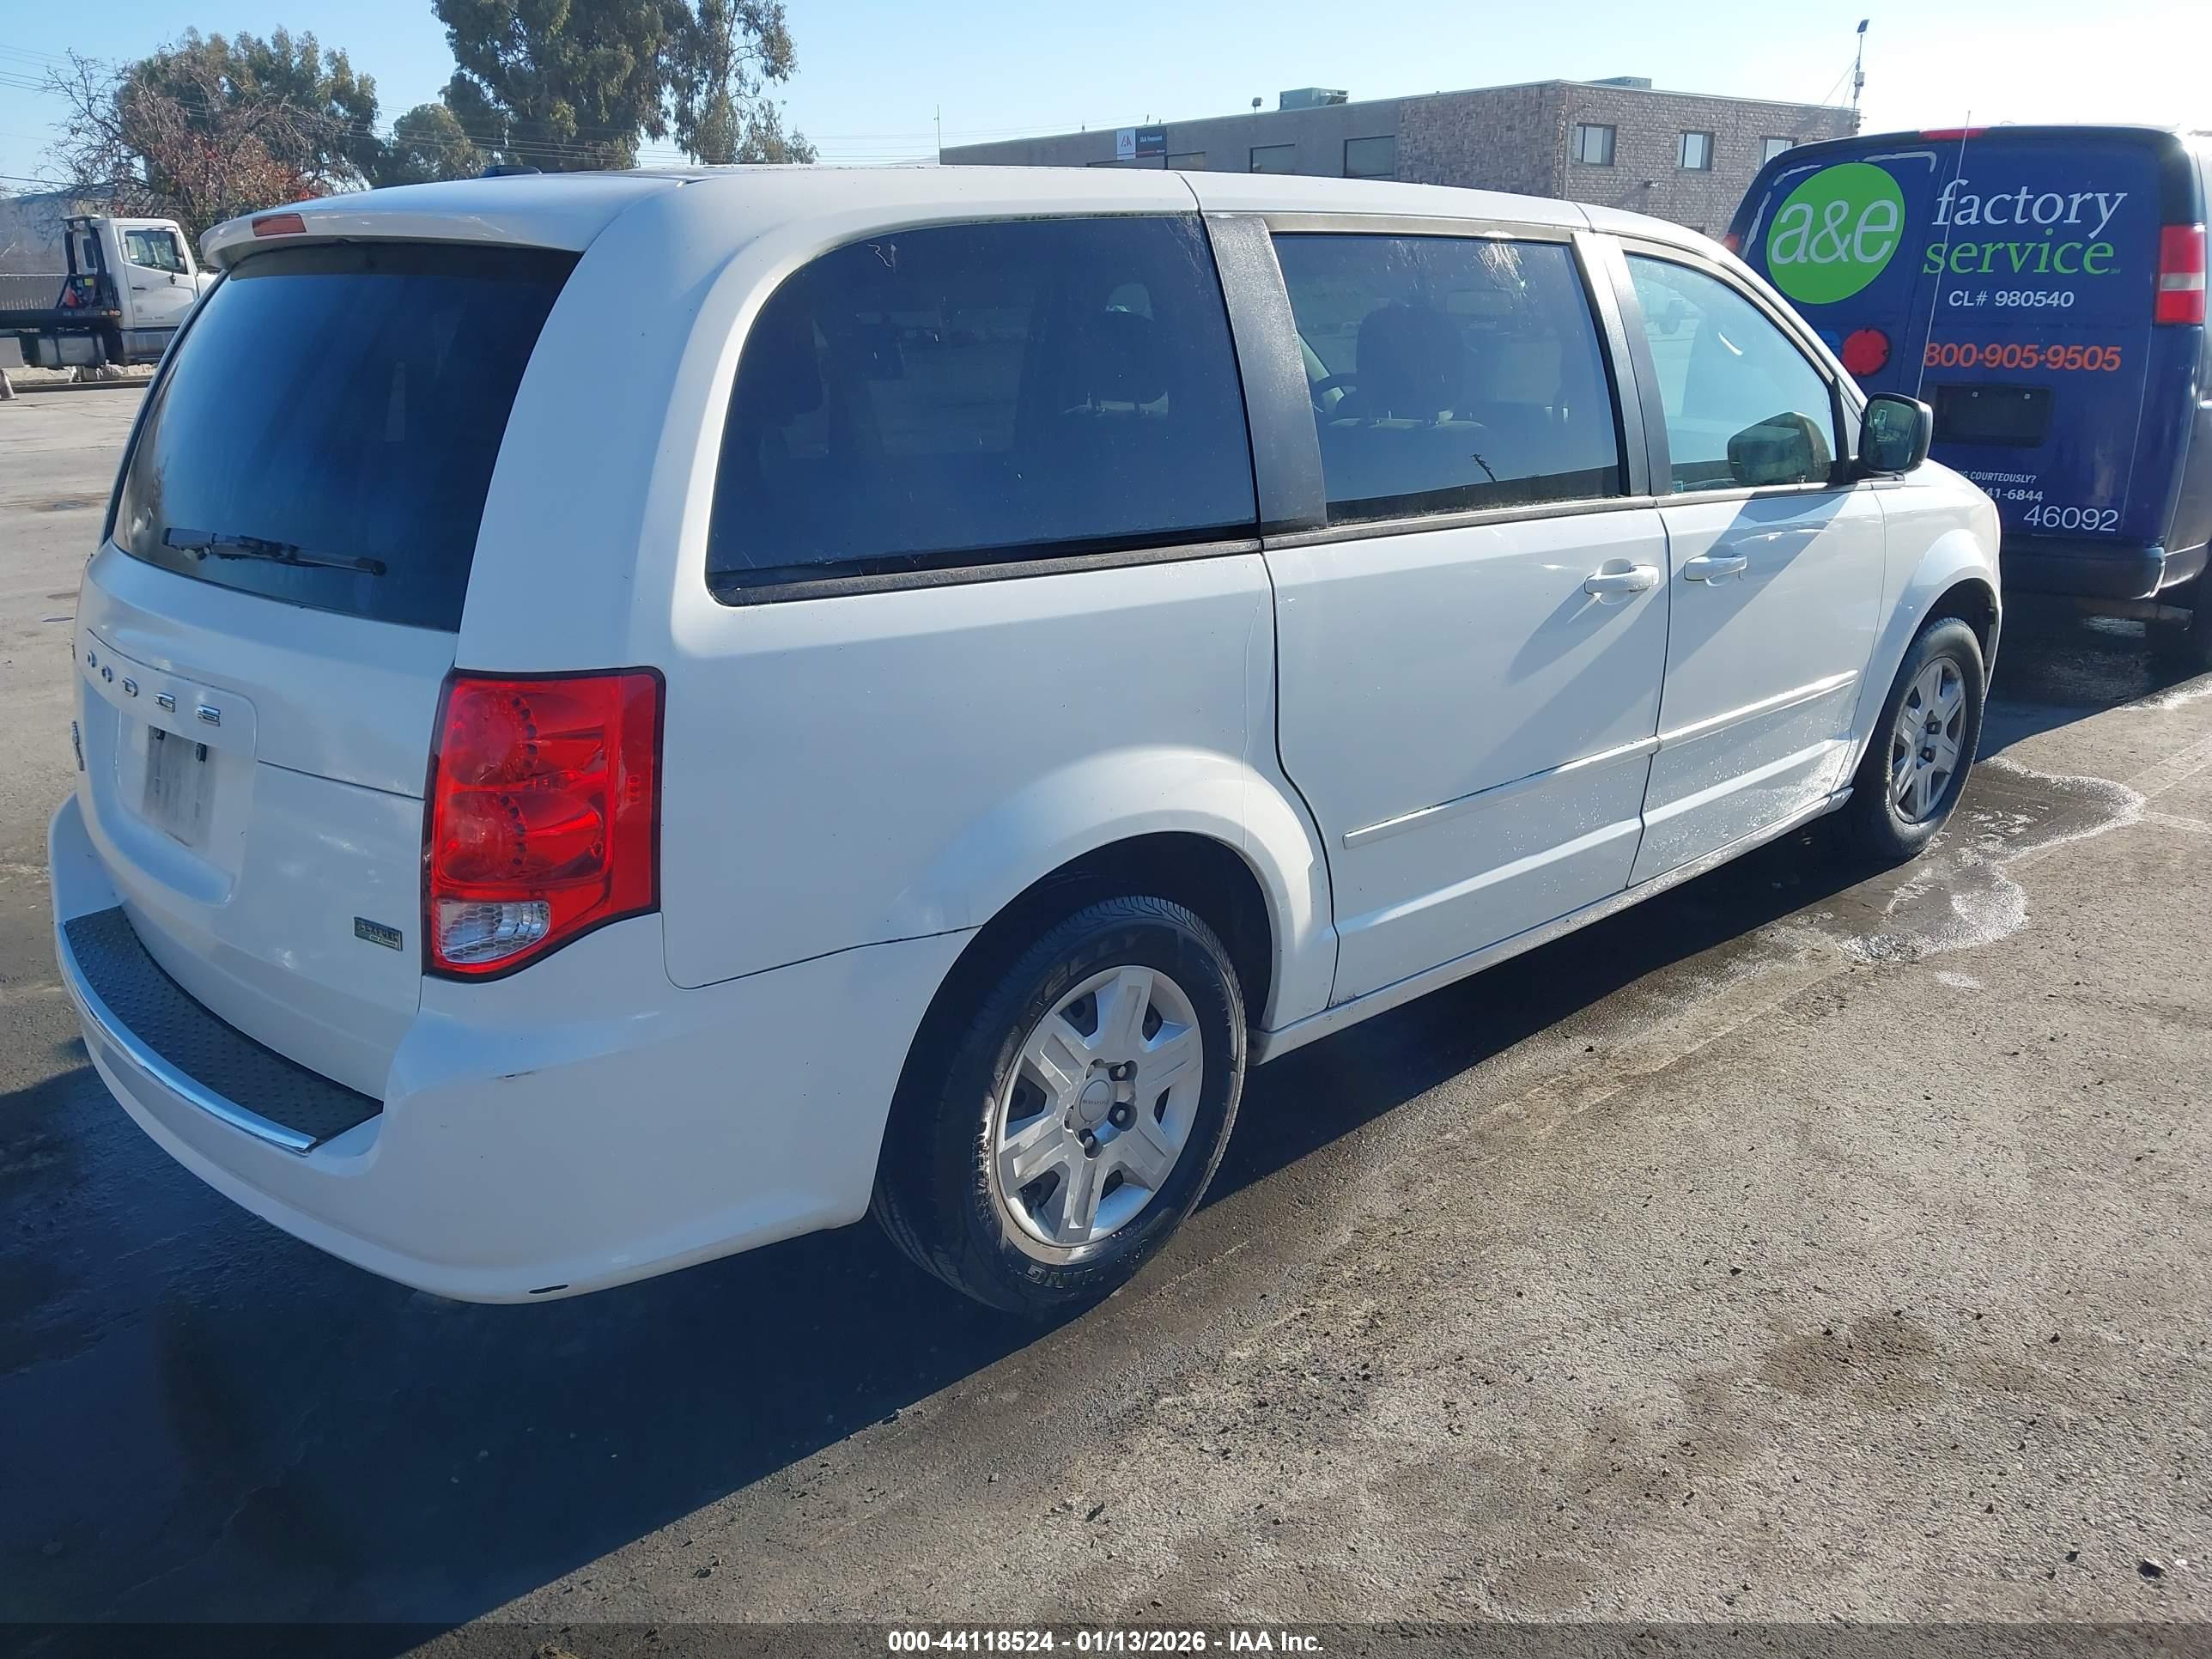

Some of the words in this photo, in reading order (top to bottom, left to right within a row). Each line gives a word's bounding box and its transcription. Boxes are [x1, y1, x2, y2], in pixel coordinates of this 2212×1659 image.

[1932, 179, 2128, 240] factory
[1771, 199, 1898, 264] a&e
[1923, 228, 2114, 274] service
[1948, 290, 1988, 307] CL#
[1994, 290, 2075, 307] 980540
[1970, 471, 2037, 483] COURTEOUSLY?
[2023, 505, 2119, 532] 46092
